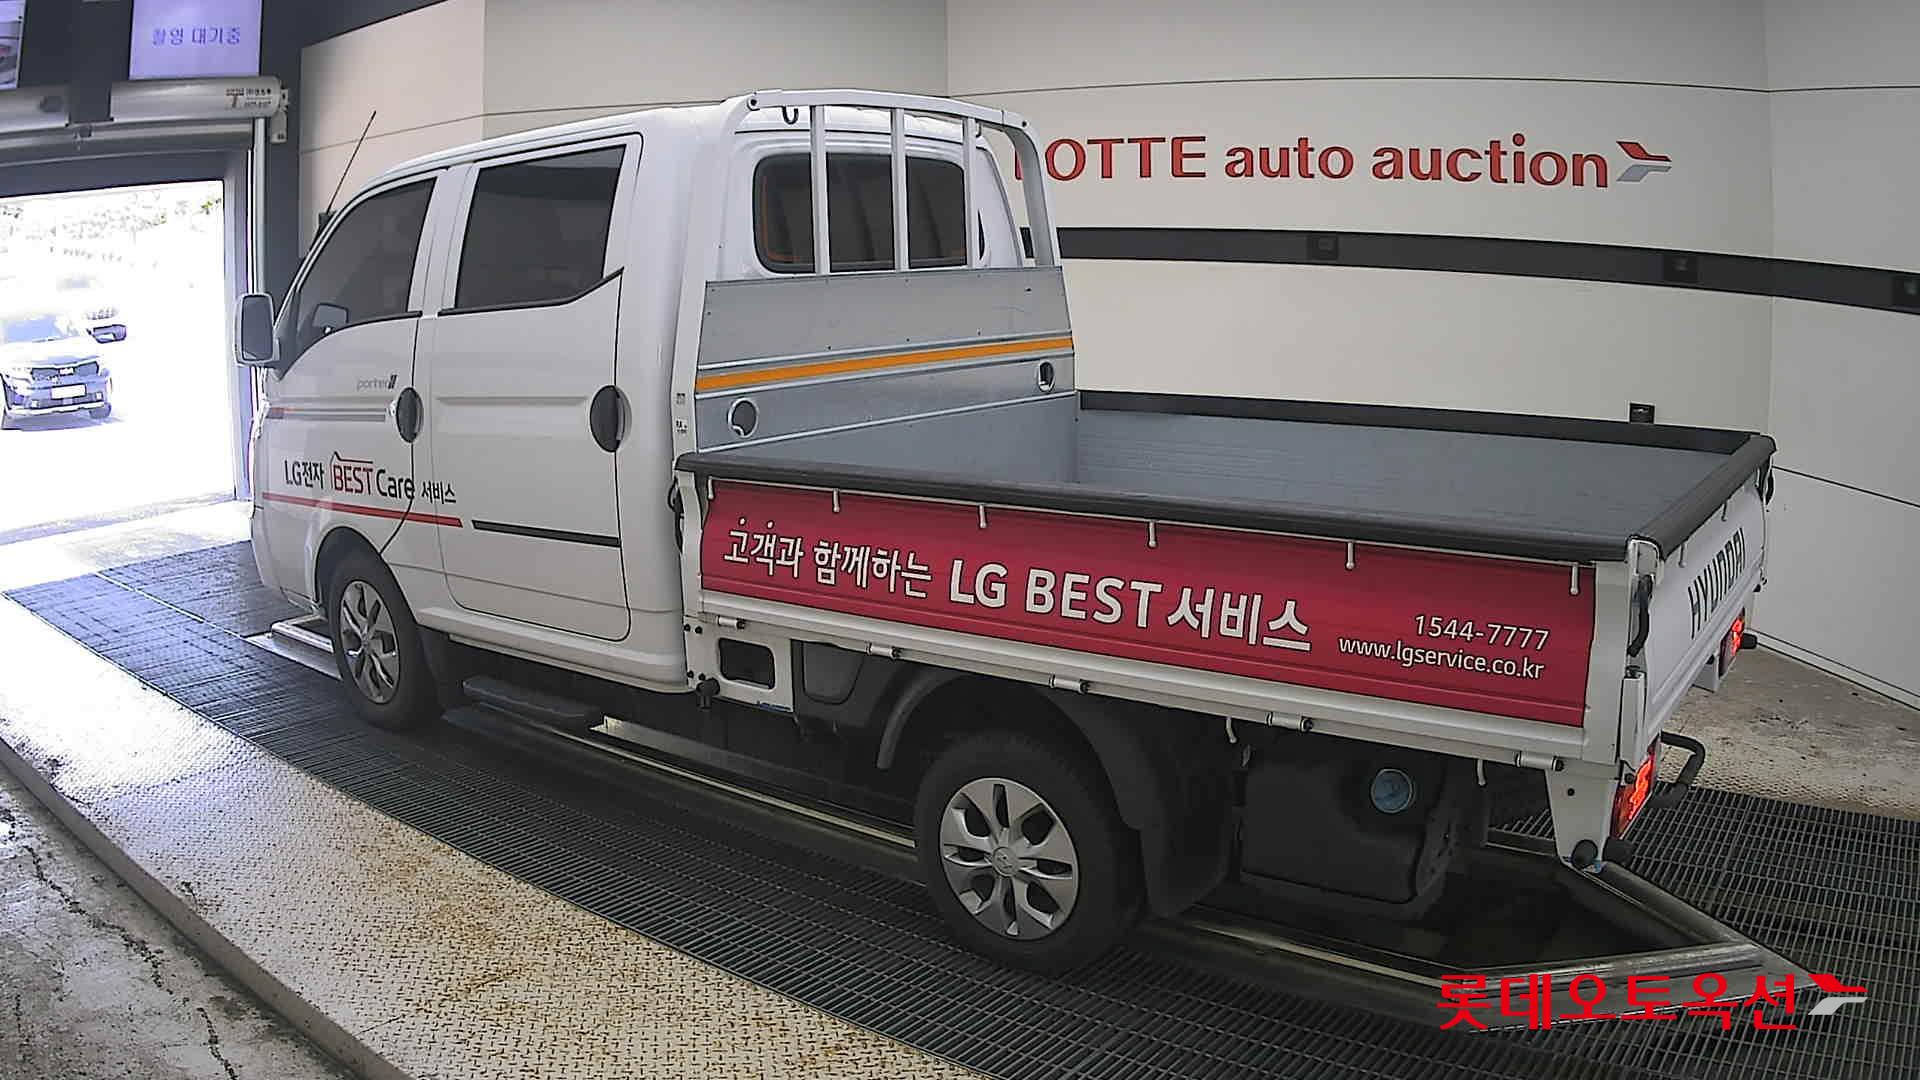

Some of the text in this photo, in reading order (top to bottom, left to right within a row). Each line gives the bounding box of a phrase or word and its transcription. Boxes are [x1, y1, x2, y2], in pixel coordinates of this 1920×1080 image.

[1224, 137, 1354, 180] auto
[1371, 133, 1608, 188] auction
[284, 459, 456, 504] LG전자 BEST Care 서비스
[723, 517, 1312, 652] 고객과 함께하는 LG BEST 서비스
[1687, 527, 1746, 641] HYUNDAI
[1415, 614, 1550, 651] 1544-7777
[1338, 637, 1545, 680] www.lgservice.co.kr
